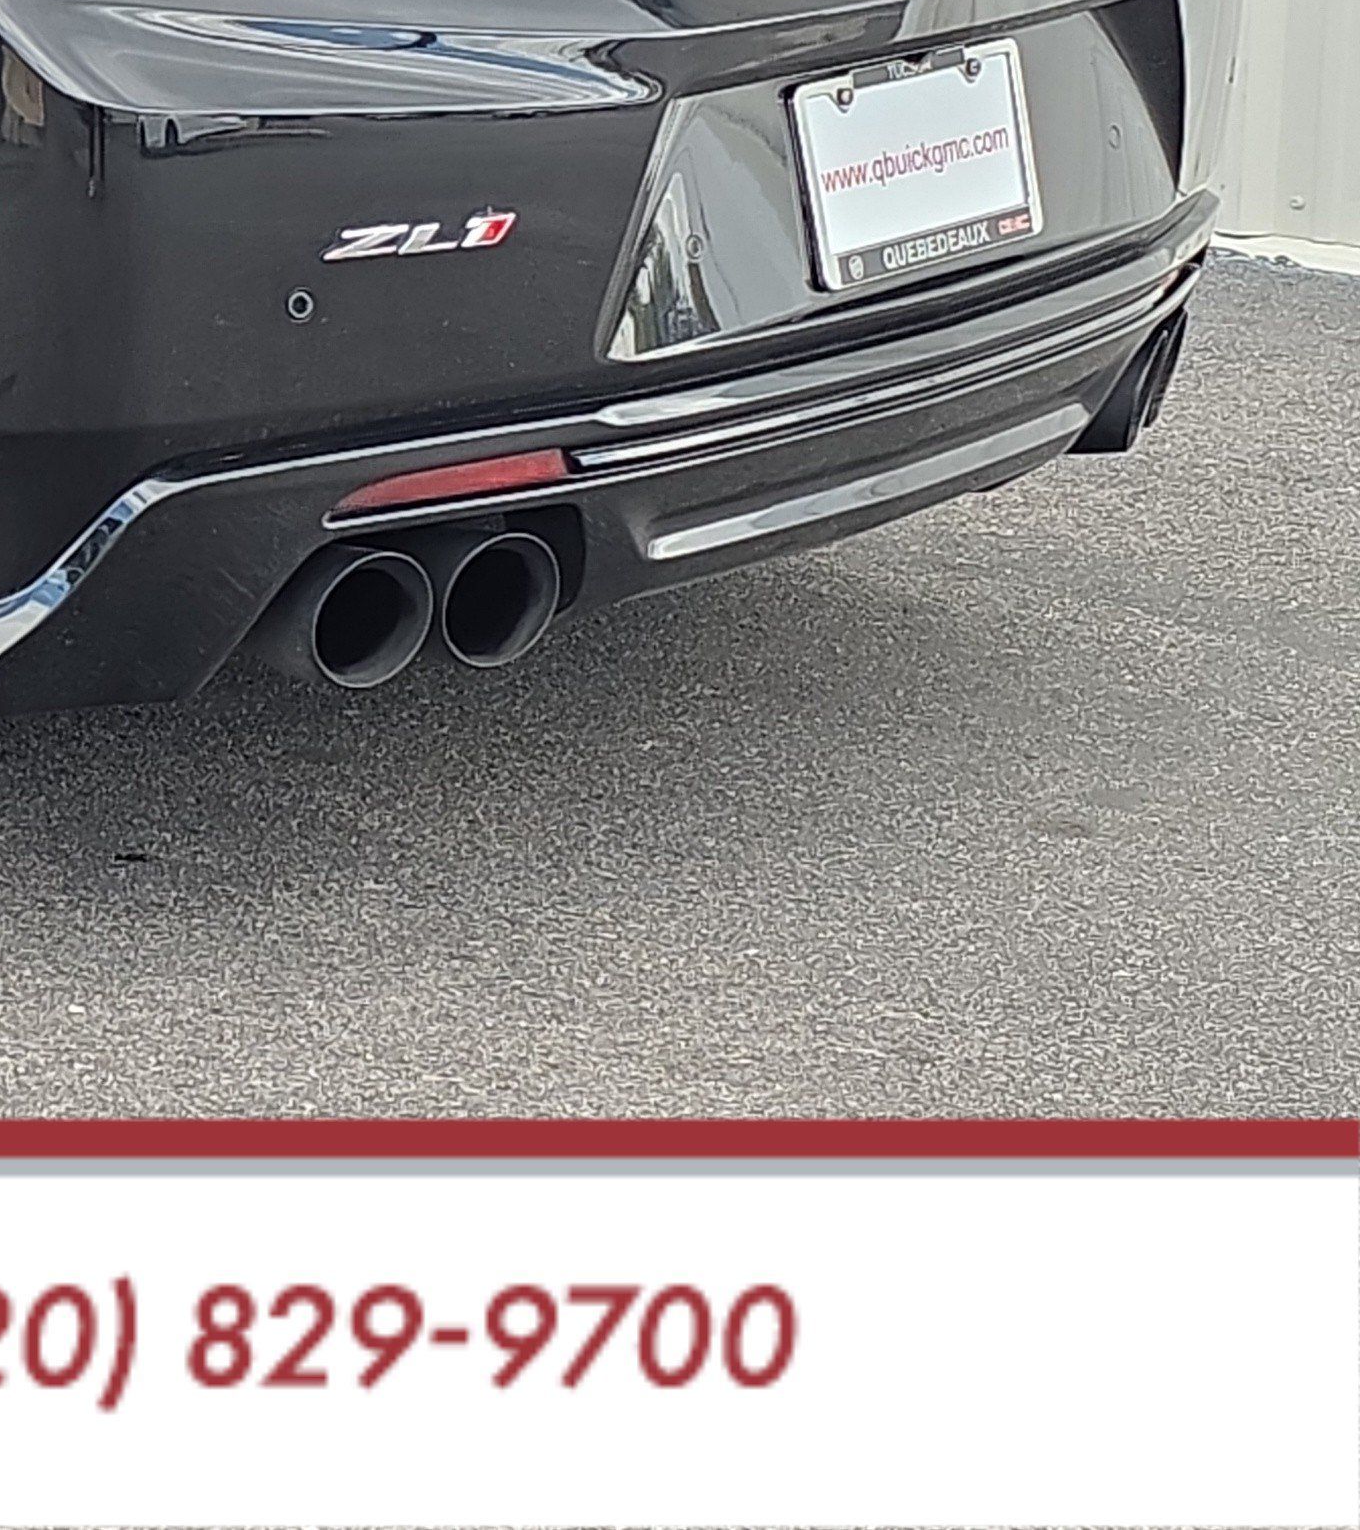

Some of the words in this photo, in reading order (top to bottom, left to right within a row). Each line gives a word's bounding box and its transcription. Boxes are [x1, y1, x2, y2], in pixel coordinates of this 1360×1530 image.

[820, 126, 1011, 193] www.qbuickgmc.com
[322, 212, 517, 260] ZL1
[882, 221, 992, 270] QUEBEDEAUX
